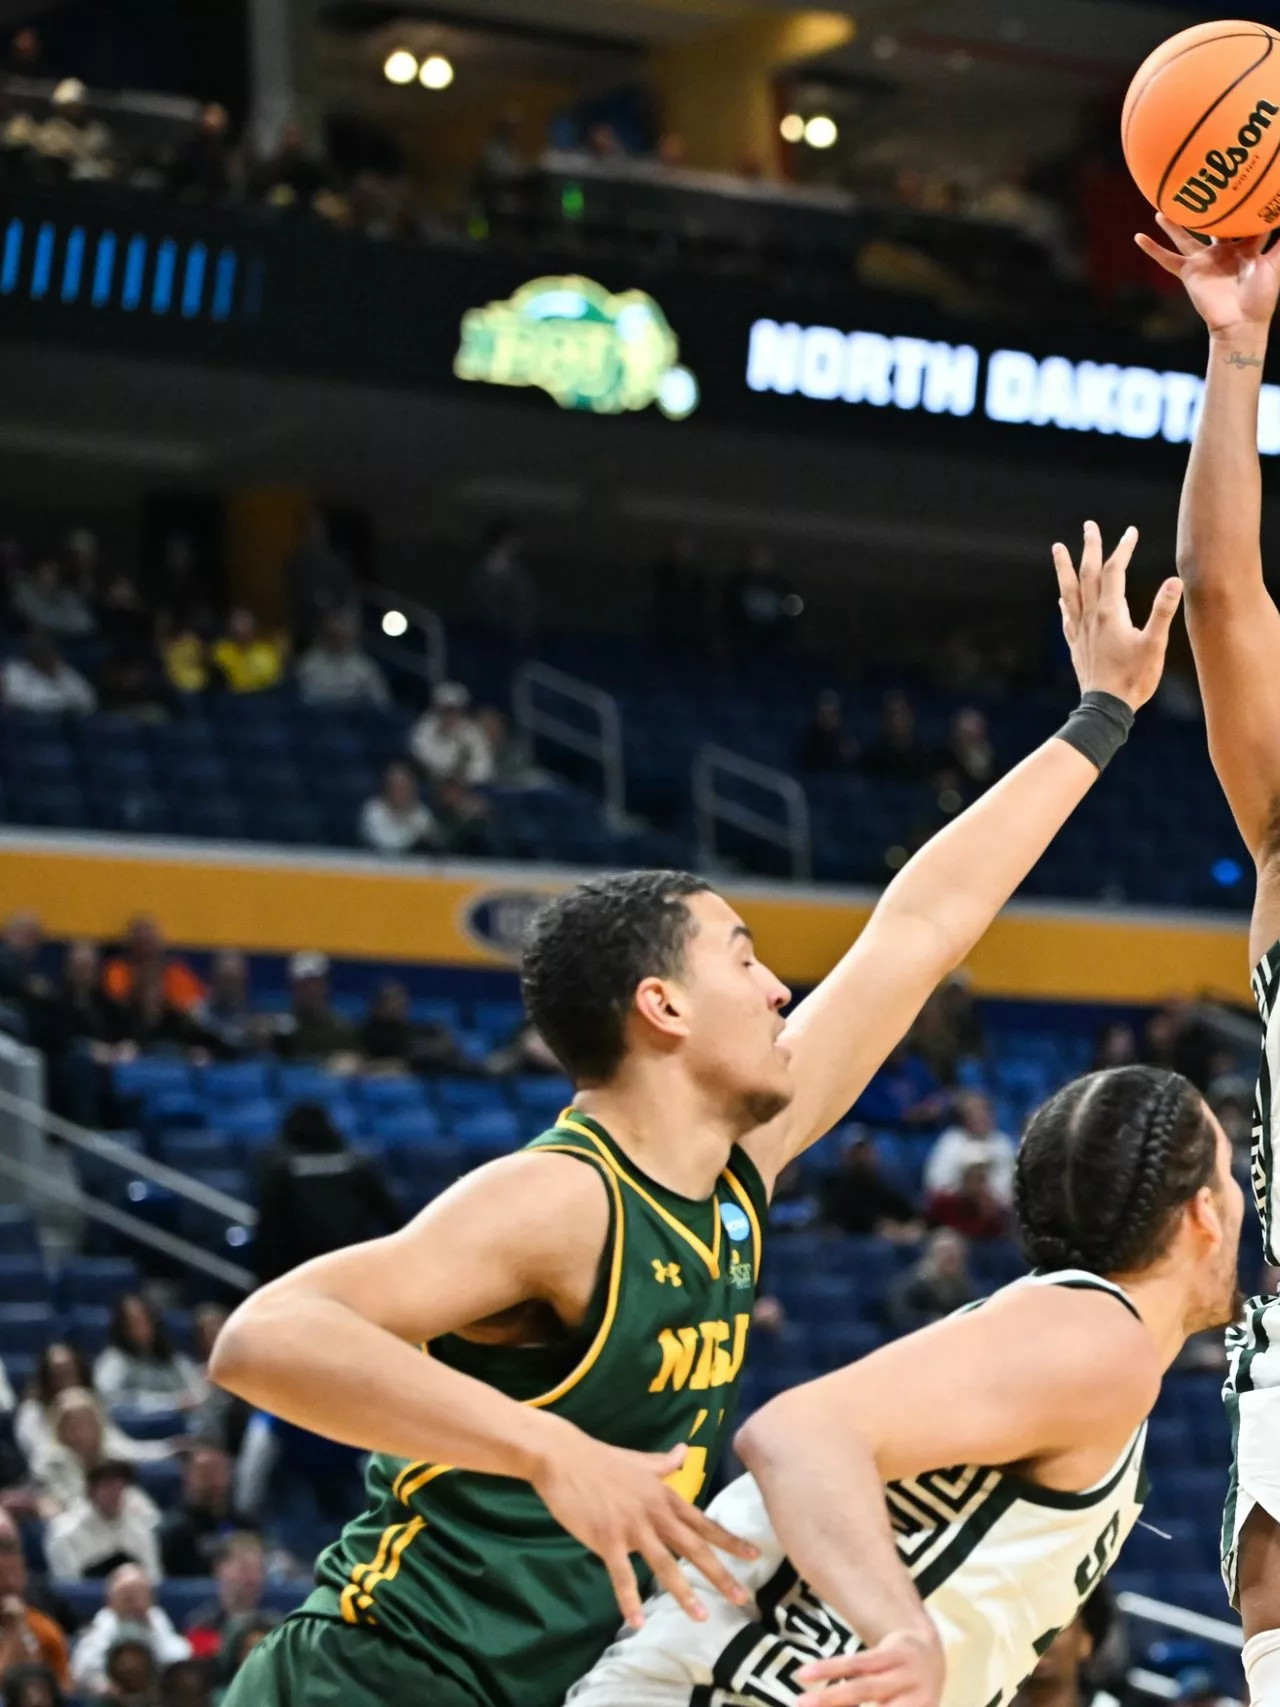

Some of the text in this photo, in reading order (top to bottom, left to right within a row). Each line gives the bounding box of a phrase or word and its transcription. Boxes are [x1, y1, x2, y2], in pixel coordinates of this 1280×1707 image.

[1173, 99, 1280, 213] Wilson
[747, 318, 979, 416] NORTH
[985, 350, 1209, 443] DAKOT
